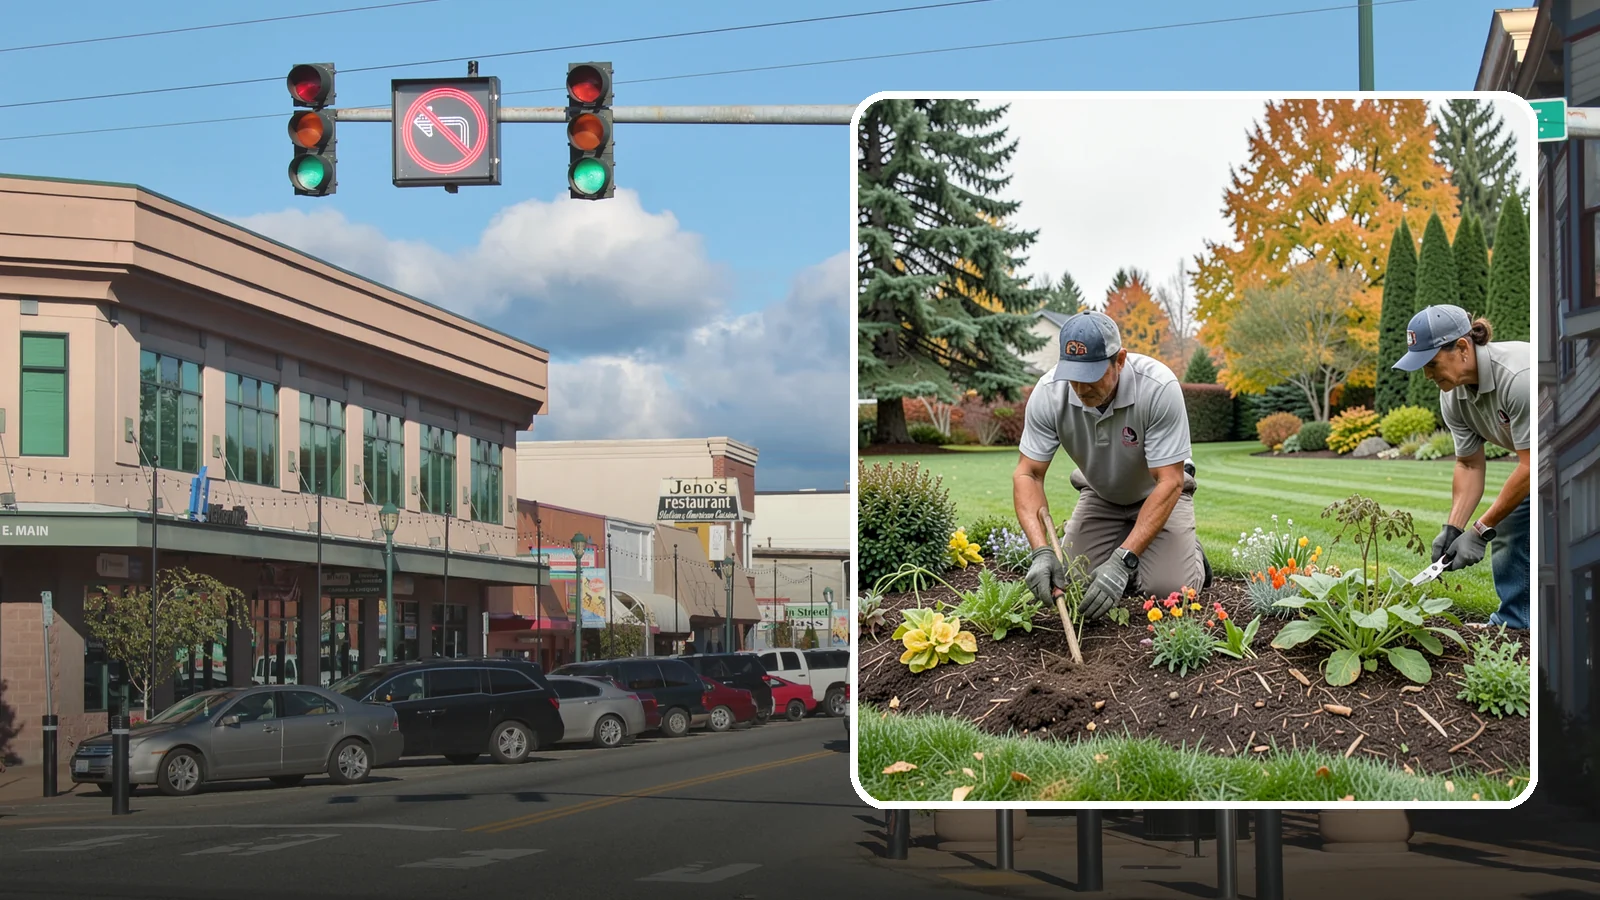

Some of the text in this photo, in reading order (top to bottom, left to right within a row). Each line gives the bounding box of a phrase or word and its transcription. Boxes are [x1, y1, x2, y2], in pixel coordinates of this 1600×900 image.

[669, 480, 728, 495] Jeno's
[664, 496, 731, 509] restaurant
[658, 509, 682, 520] Italian
[686, 509, 714, 519] American
[714, 509, 738, 519] Cuisine
[2, 525, 49, 537] E. MAIN
[797, 607, 828, 617] Street
